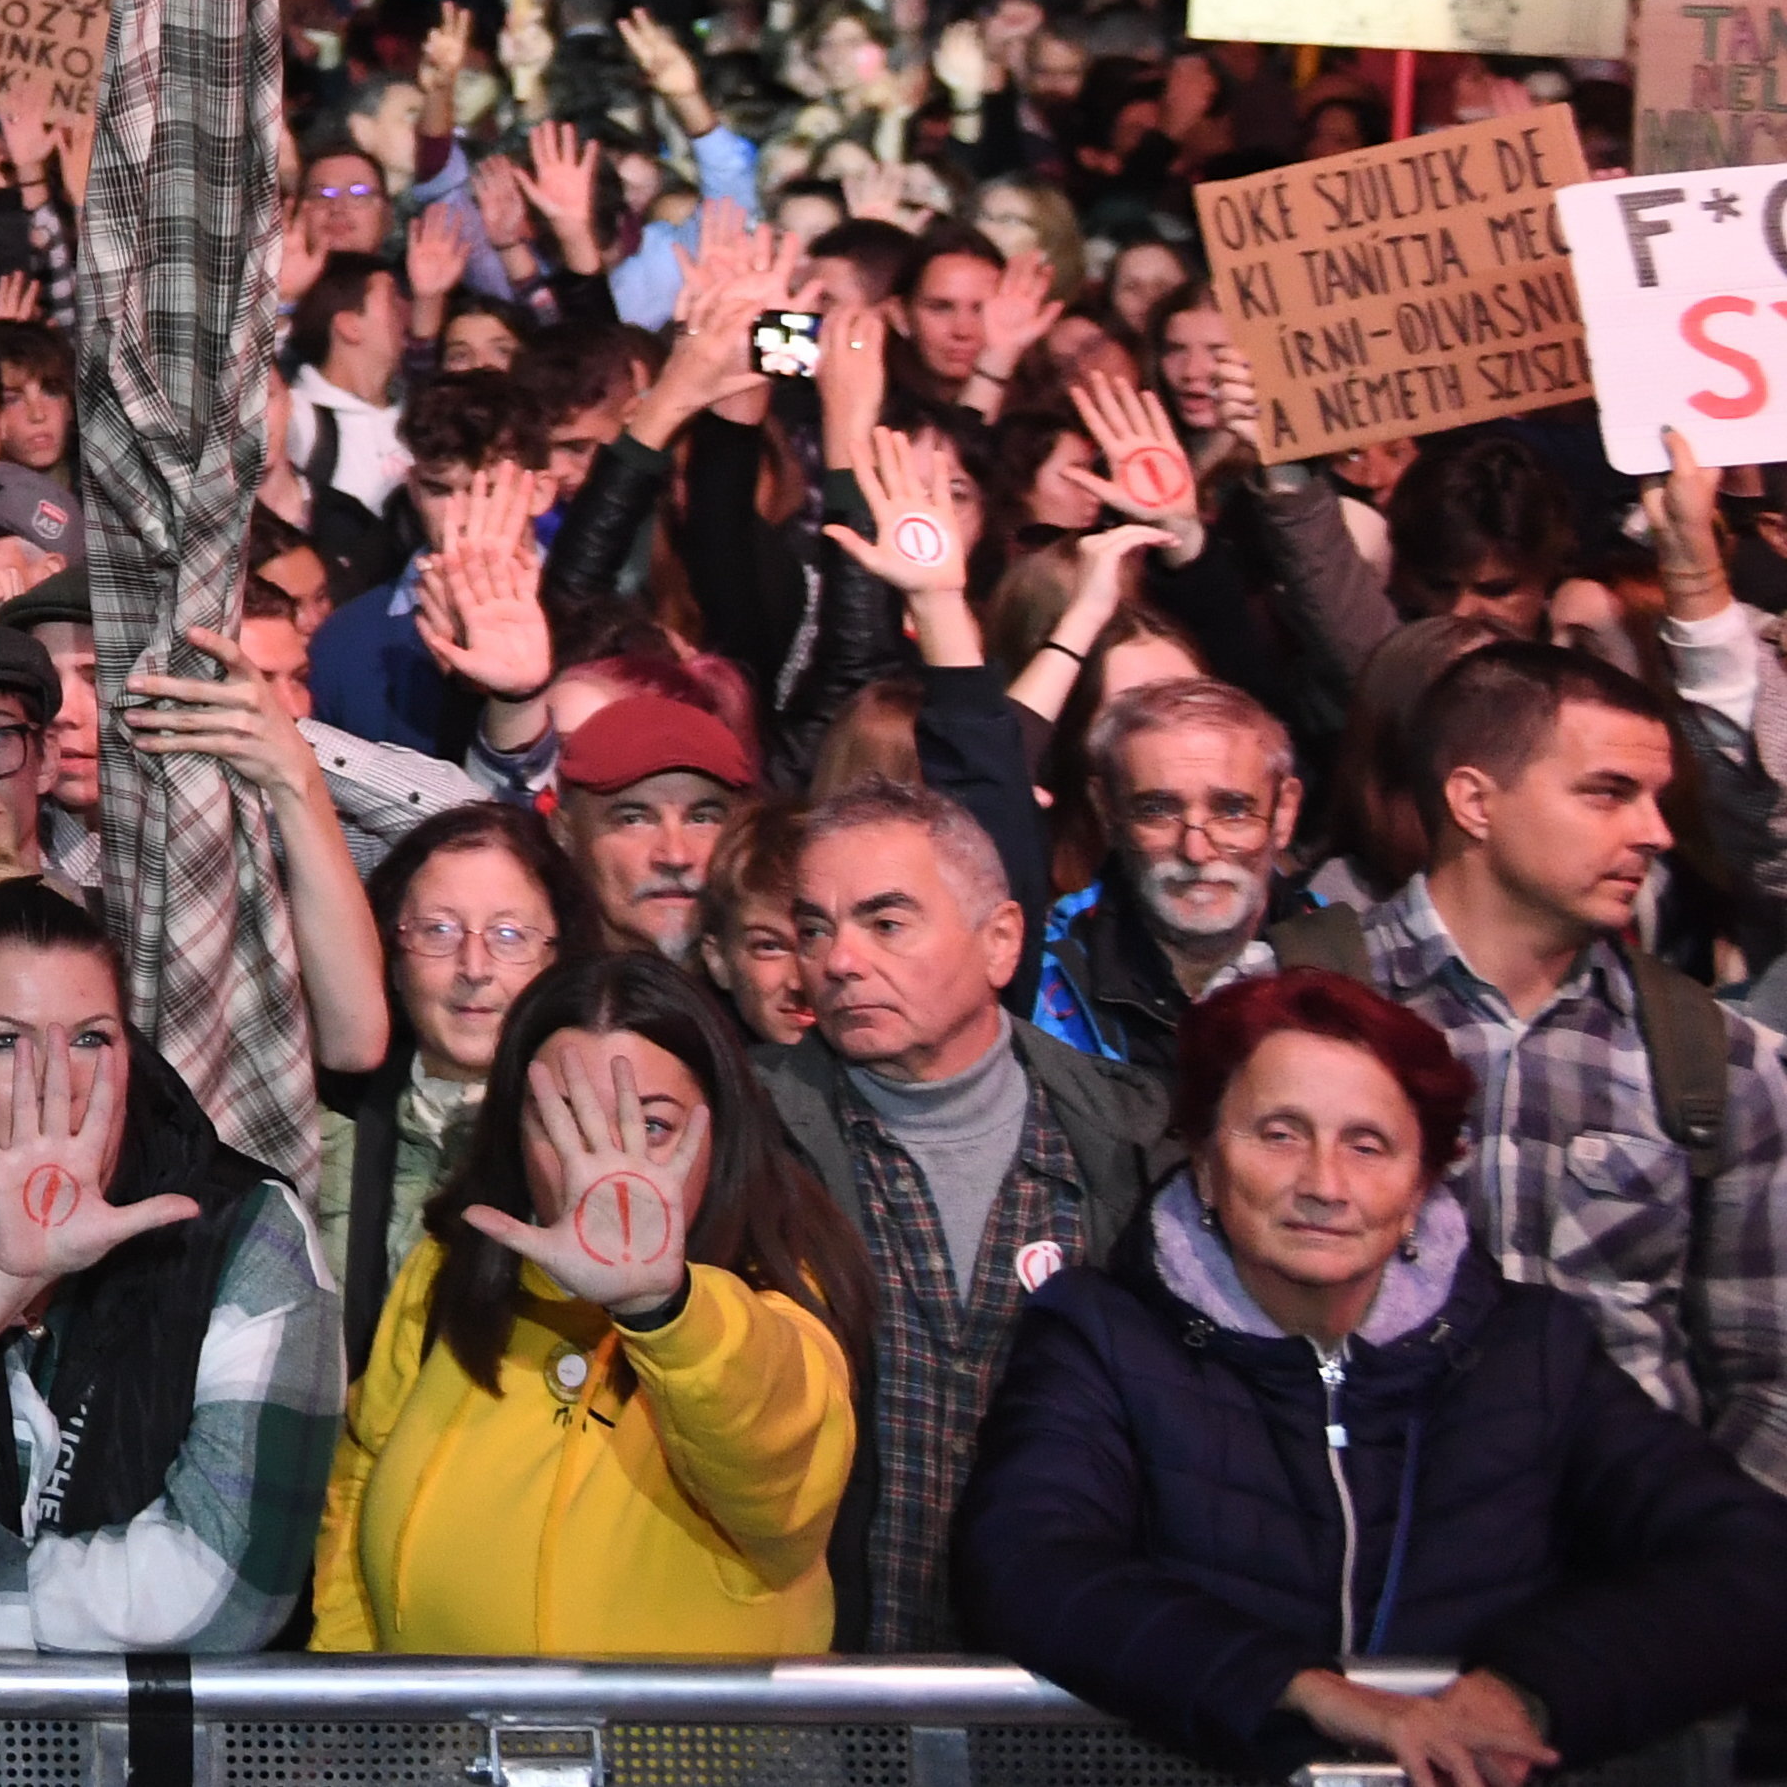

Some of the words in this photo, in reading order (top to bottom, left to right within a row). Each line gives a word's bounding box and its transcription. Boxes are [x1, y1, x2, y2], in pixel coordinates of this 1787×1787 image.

[1213, 174, 1298, 251] OKÉ
[1493, 126, 1553, 195] DE
[1230, 261, 1281, 320] KI
[1298, 228, 1470, 307] TANÍTJA
[1269, 397, 1298, 448] A
[1314, 364, 1467, 434] NÉMETH
[1679, 295, 1787, 420] S
